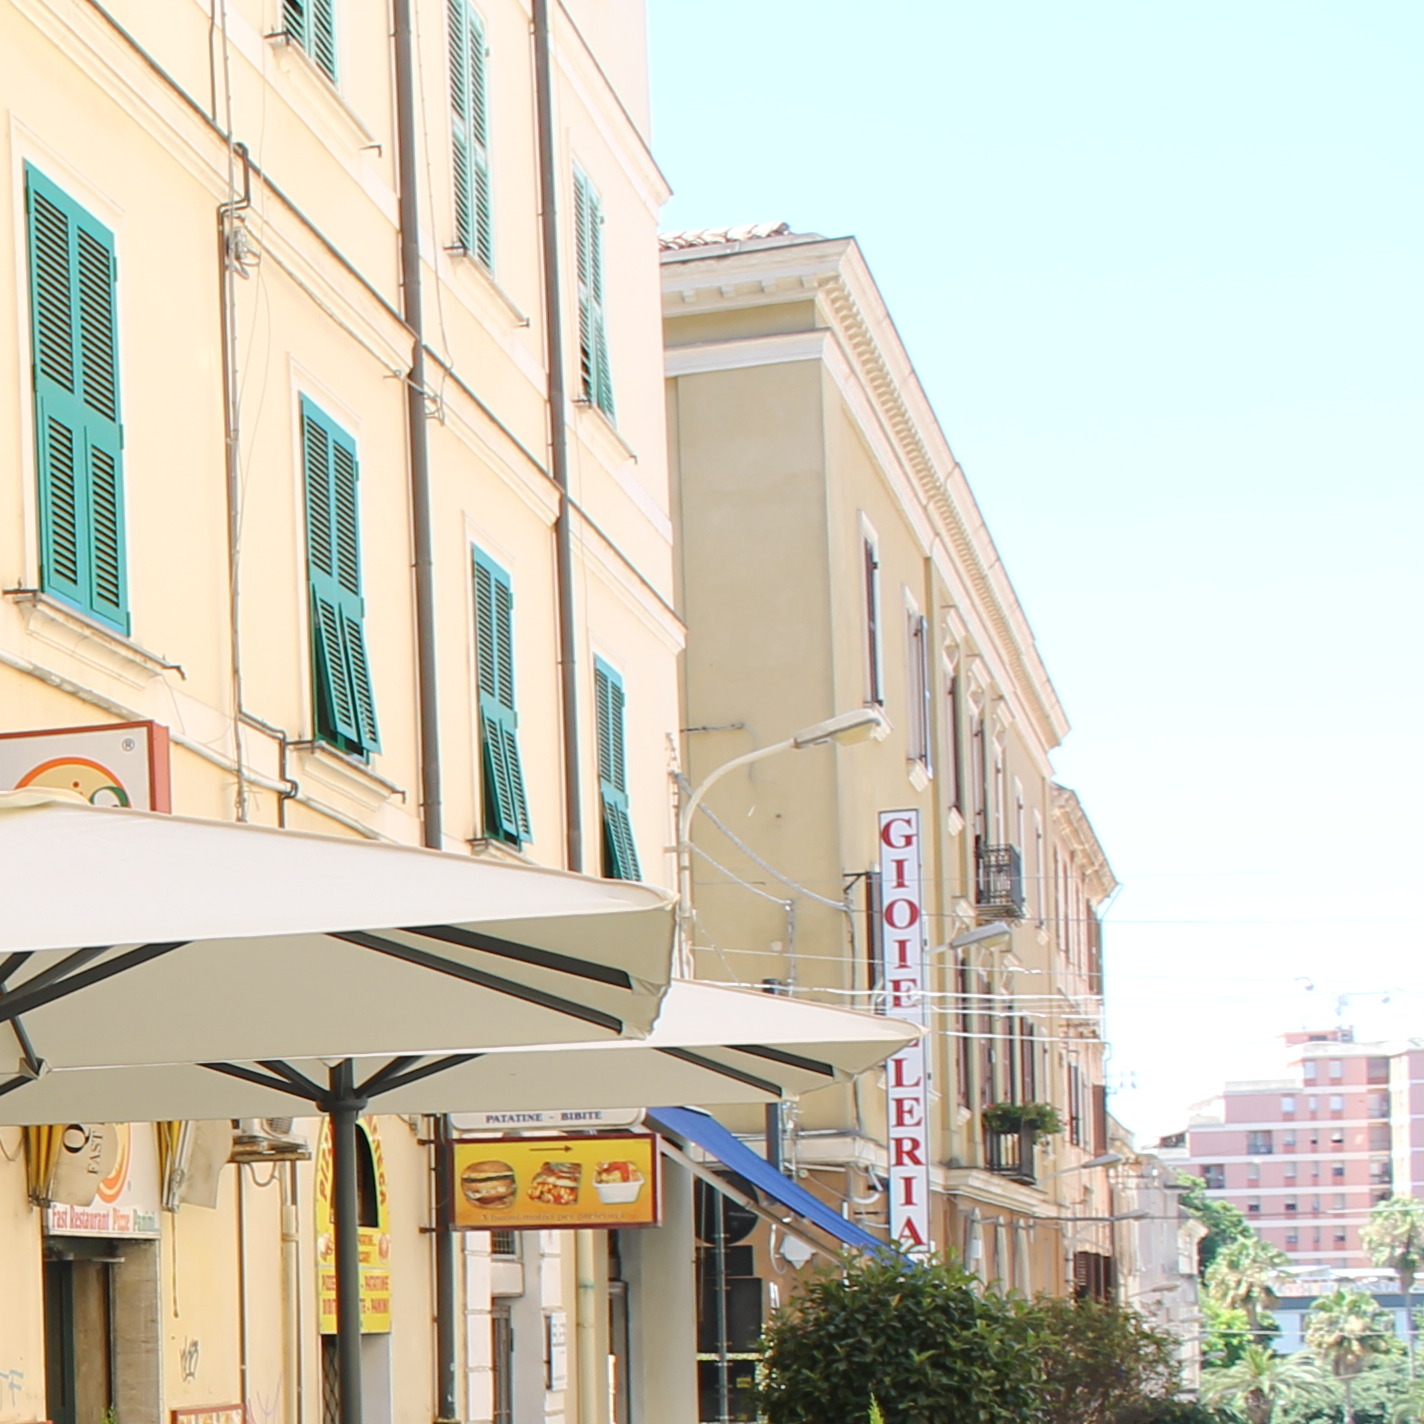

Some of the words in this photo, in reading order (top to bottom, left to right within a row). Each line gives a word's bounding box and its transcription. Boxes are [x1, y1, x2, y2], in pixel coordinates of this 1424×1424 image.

[485, 1113, 543, 1123] PATATINE
[560, 1111, 603, 1121] BIBITE
[881, 817, 927, 1247] GIOIELERIA
